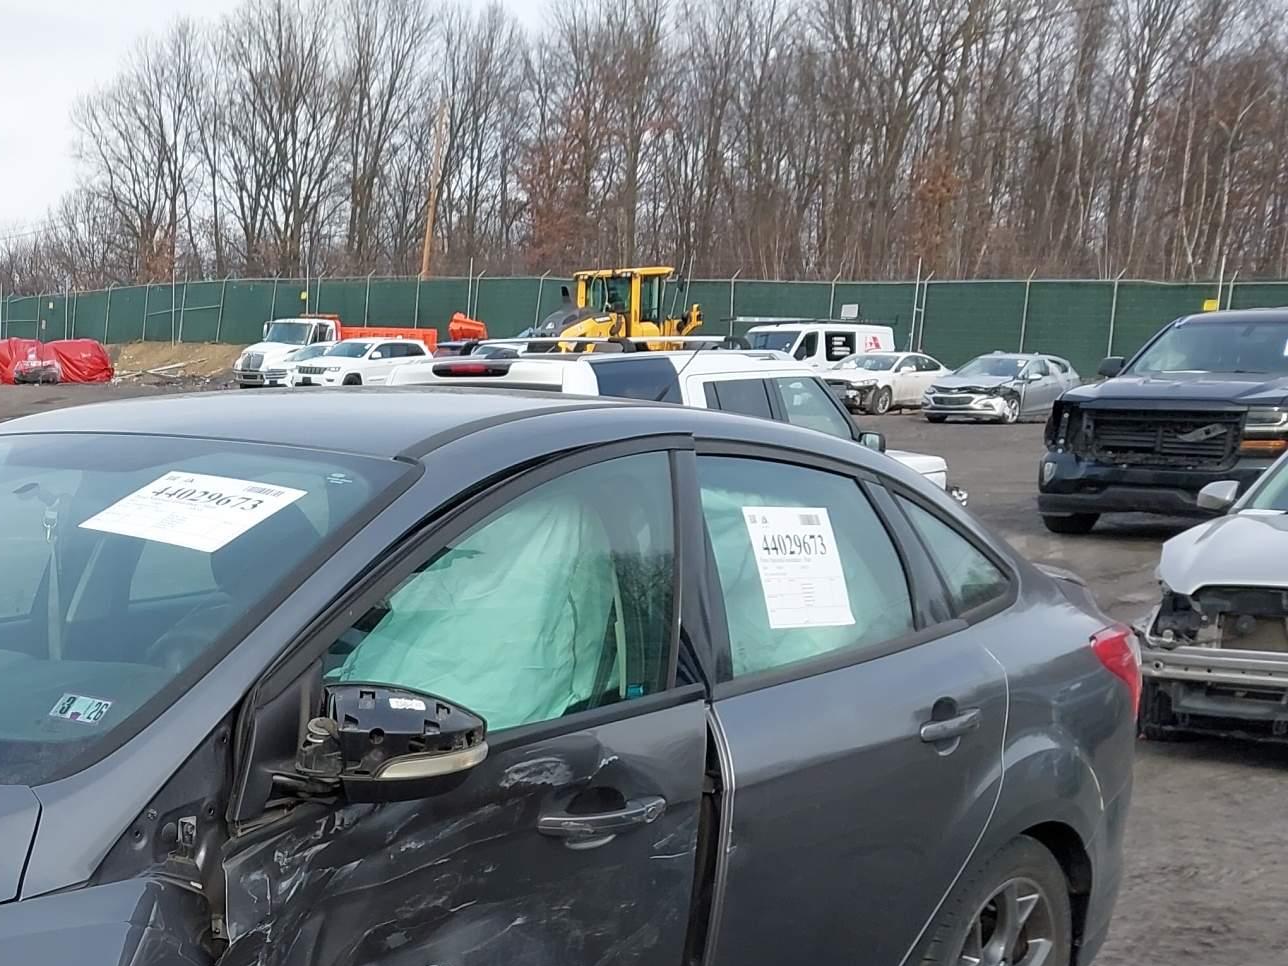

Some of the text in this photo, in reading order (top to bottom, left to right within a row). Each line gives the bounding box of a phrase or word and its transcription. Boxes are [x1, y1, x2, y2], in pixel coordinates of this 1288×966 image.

[152, 486, 264, 511] 44029673
[763, 534, 827, 555] 44029673
[86, 701, 109, 721] 26
